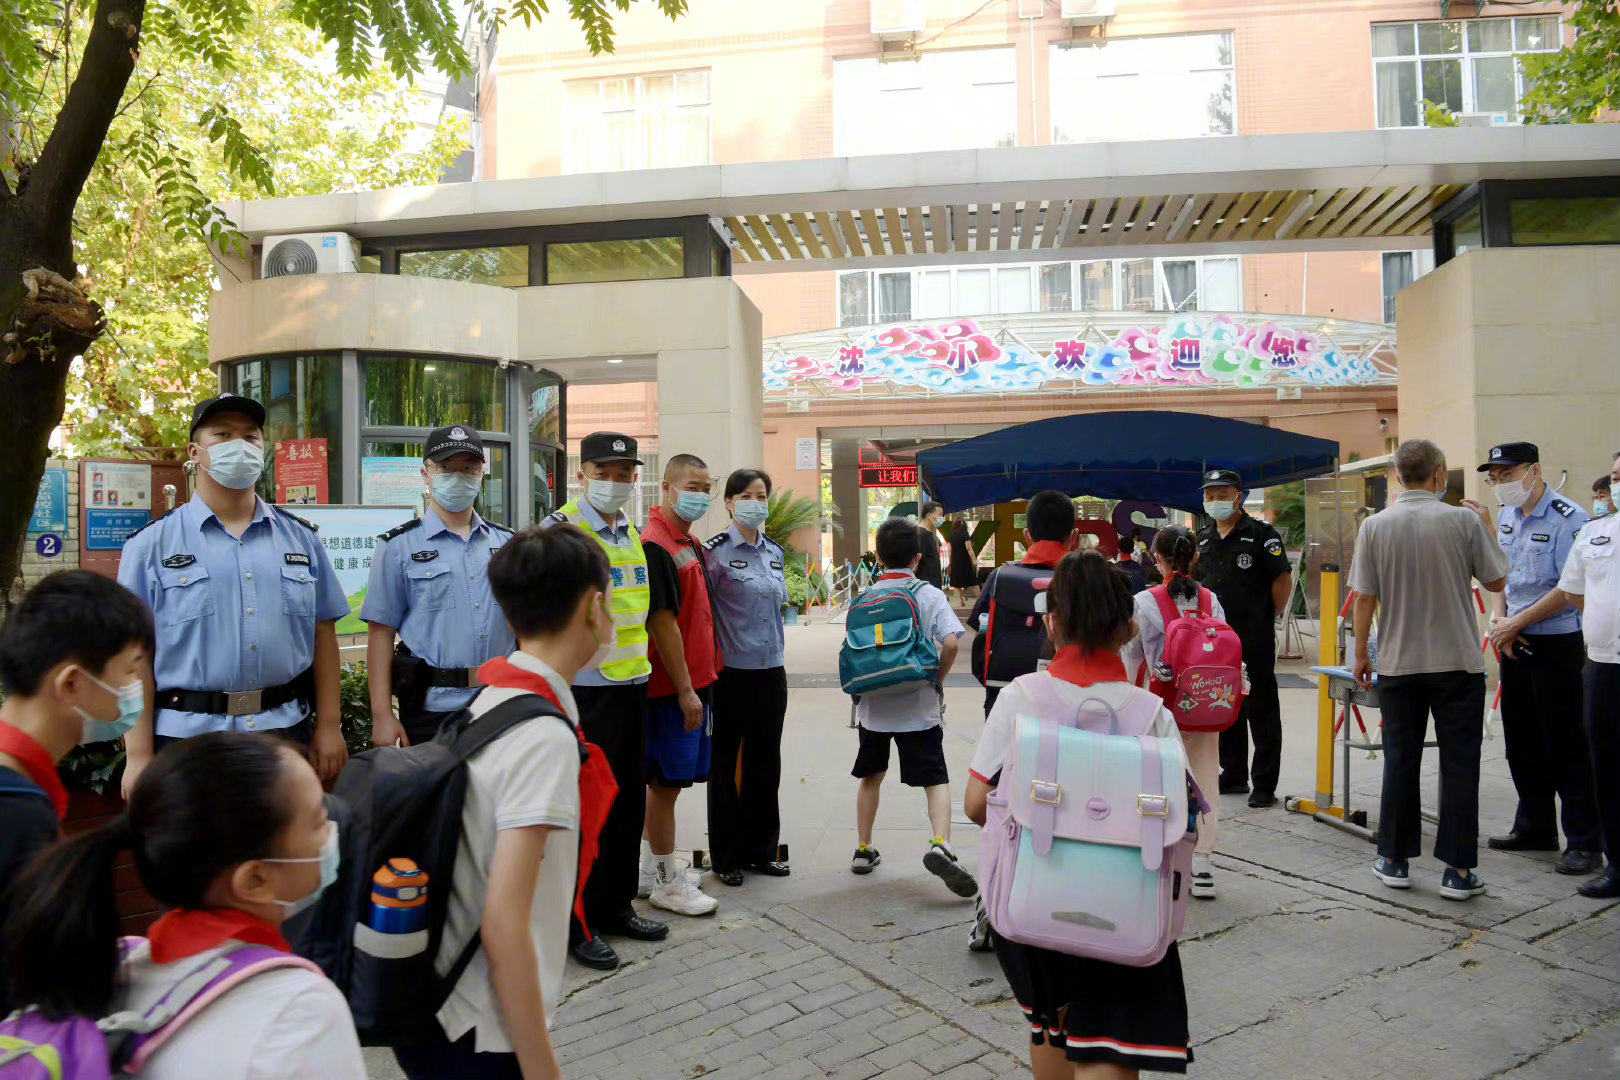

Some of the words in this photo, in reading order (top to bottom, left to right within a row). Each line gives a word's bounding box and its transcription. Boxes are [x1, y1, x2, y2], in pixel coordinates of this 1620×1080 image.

[878, 469, 918, 483] 让我们
[43, 537, 56, 554] 2
[609, 566, 647, 587] 警察
